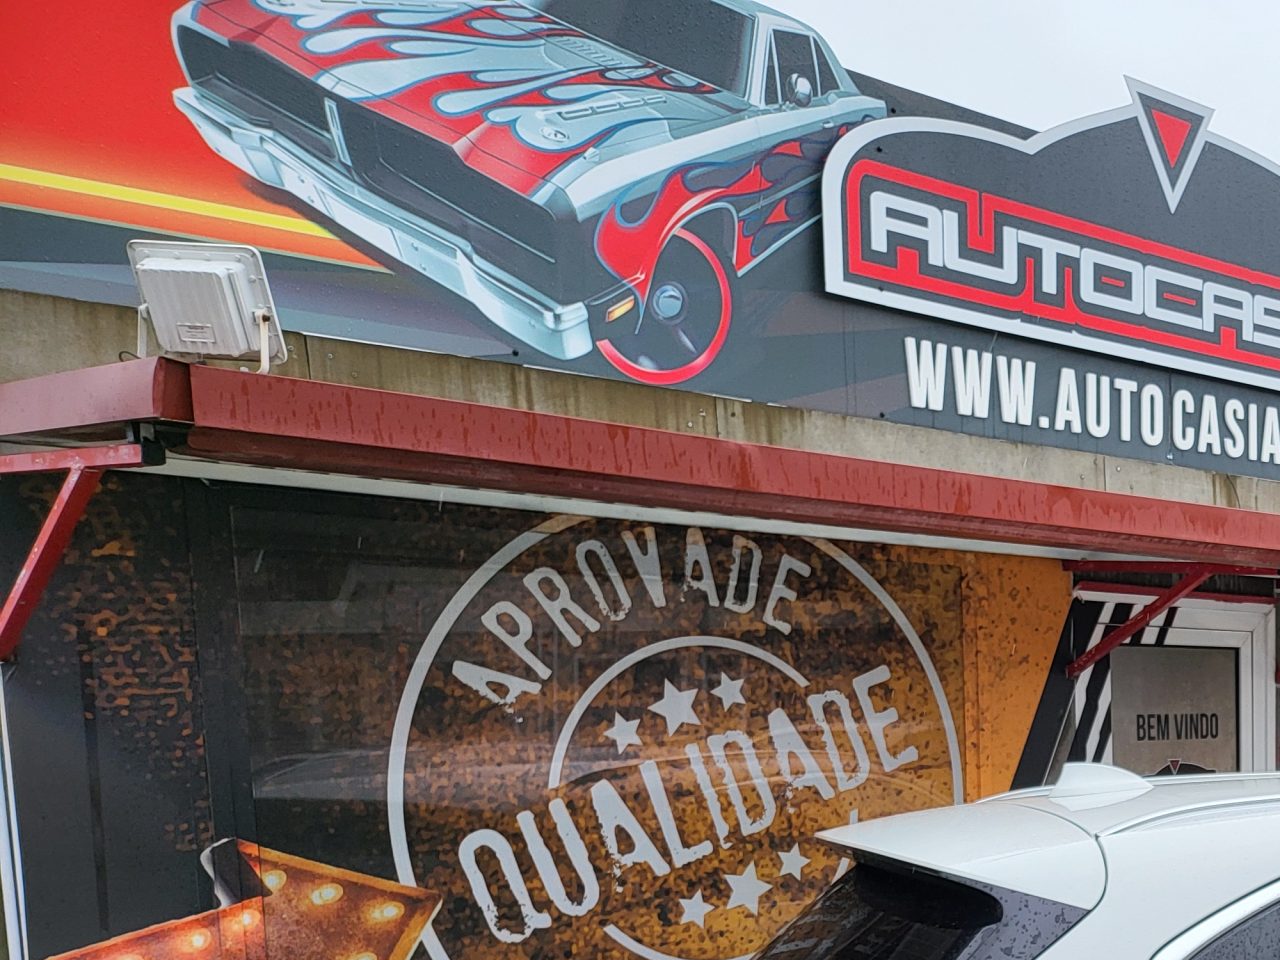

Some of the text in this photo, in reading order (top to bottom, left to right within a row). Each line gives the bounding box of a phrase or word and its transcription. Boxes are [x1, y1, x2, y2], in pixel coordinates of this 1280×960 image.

[451, 524, 813, 712] APROVADE
[457, 664, 918, 944] QUALIDADE
[1136, 713, 1219, 741] BEM VINDO
